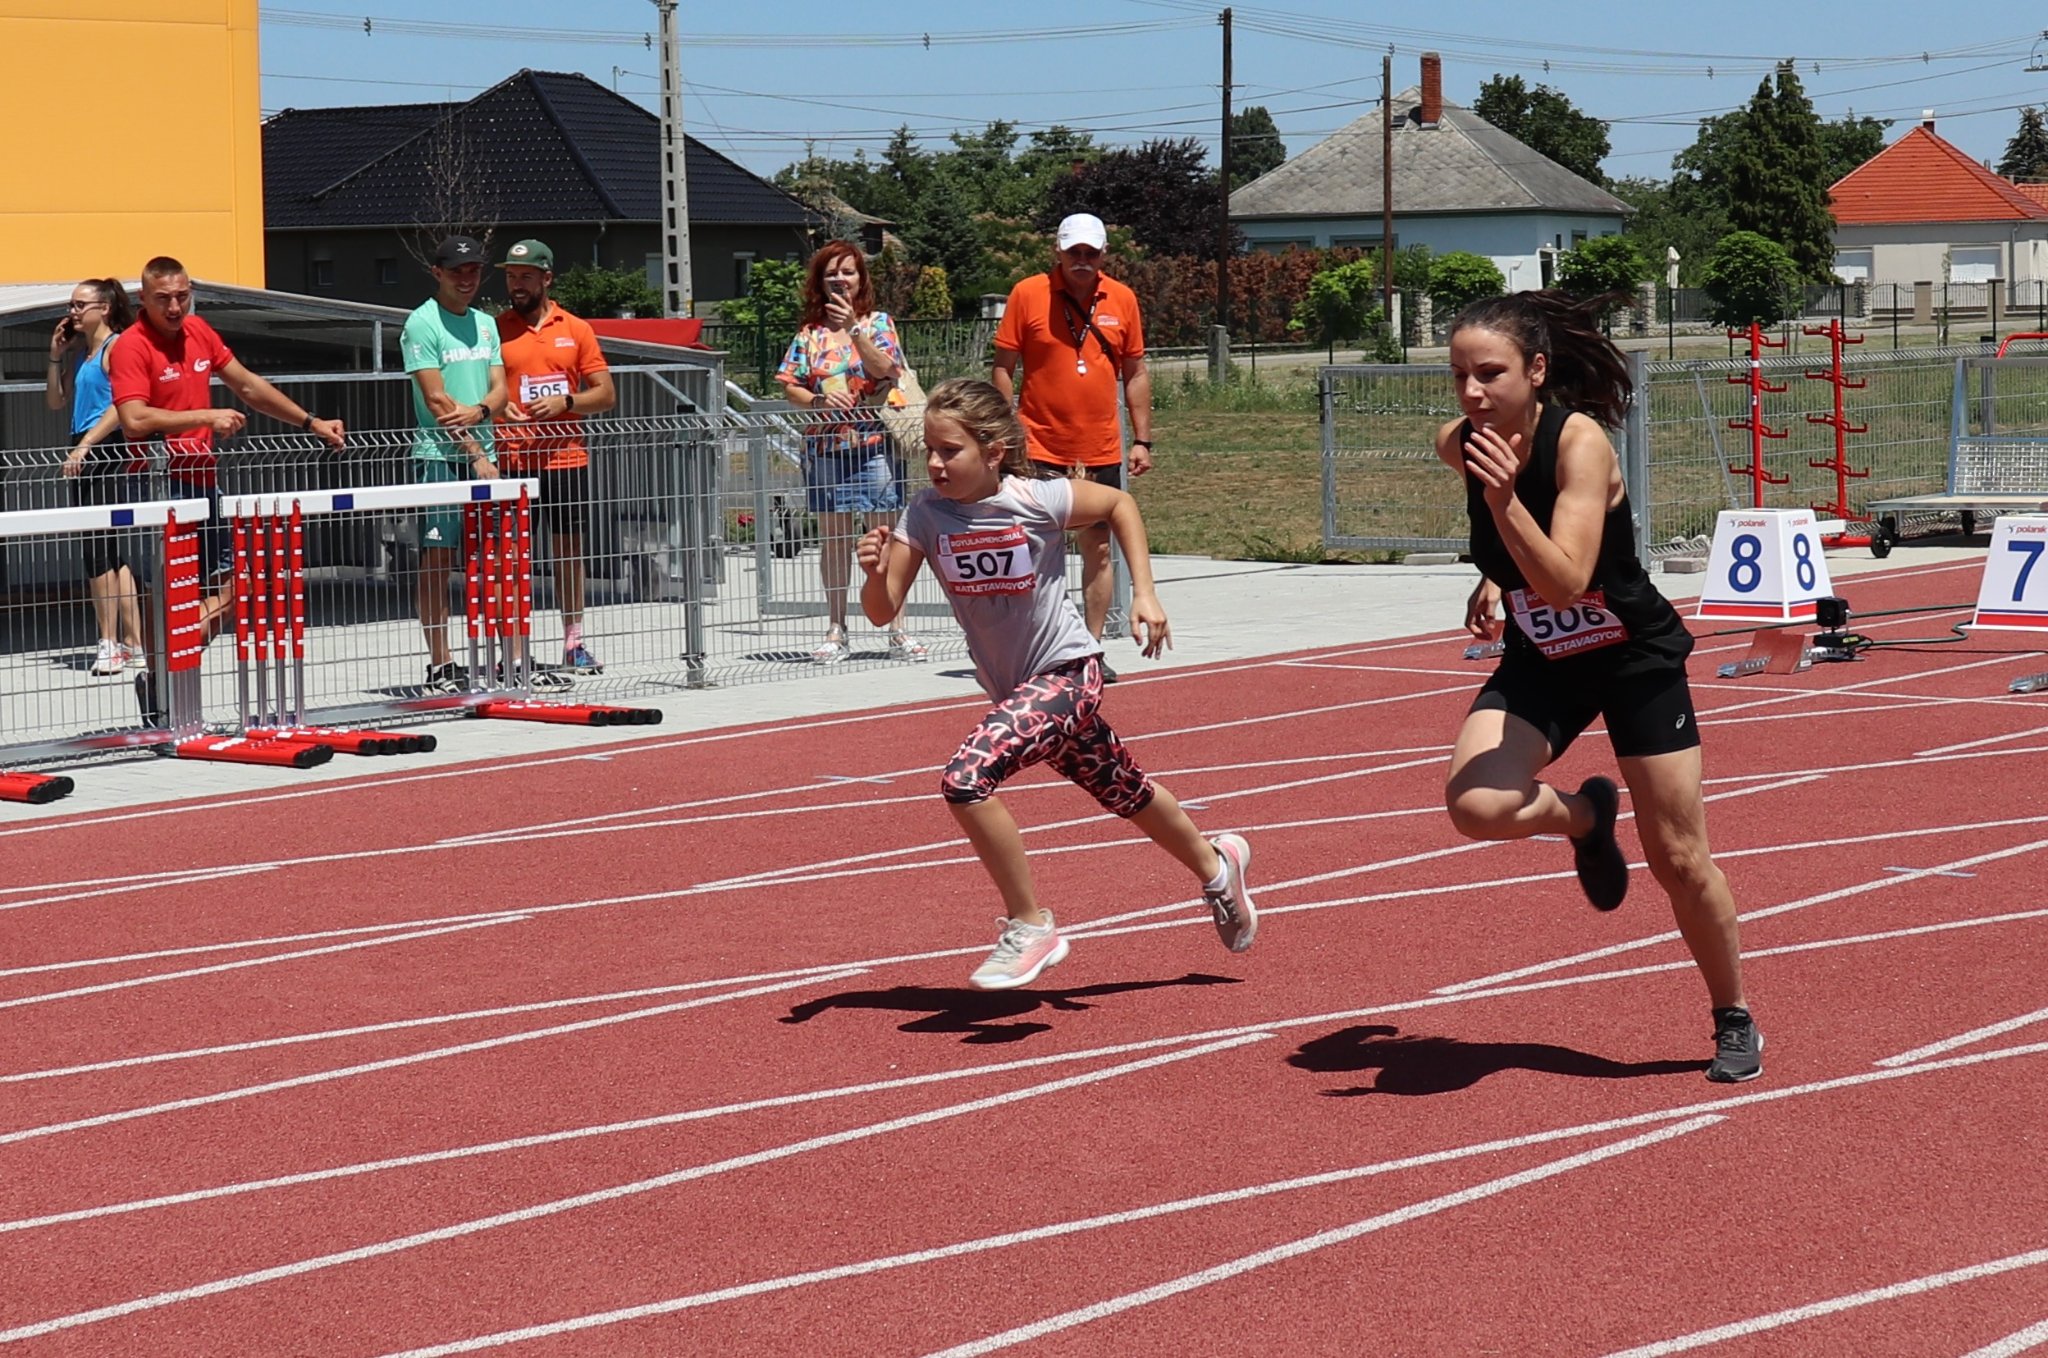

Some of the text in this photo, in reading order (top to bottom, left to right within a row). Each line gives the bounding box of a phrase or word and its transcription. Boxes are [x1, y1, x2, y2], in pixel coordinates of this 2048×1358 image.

[529, 383, 562, 400] 505
[2016, 525, 2047, 534] polanik
[955, 550, 1014, 580] 507
[1728, 534, 1762, 593] 8
[1793, 533, 1815, 591] 8
[2008, 540, 2045, 602] 7
[1530, 605, 1605, 640] 506
[1541, 629, 1623, 656] TLETAVAGYOK
